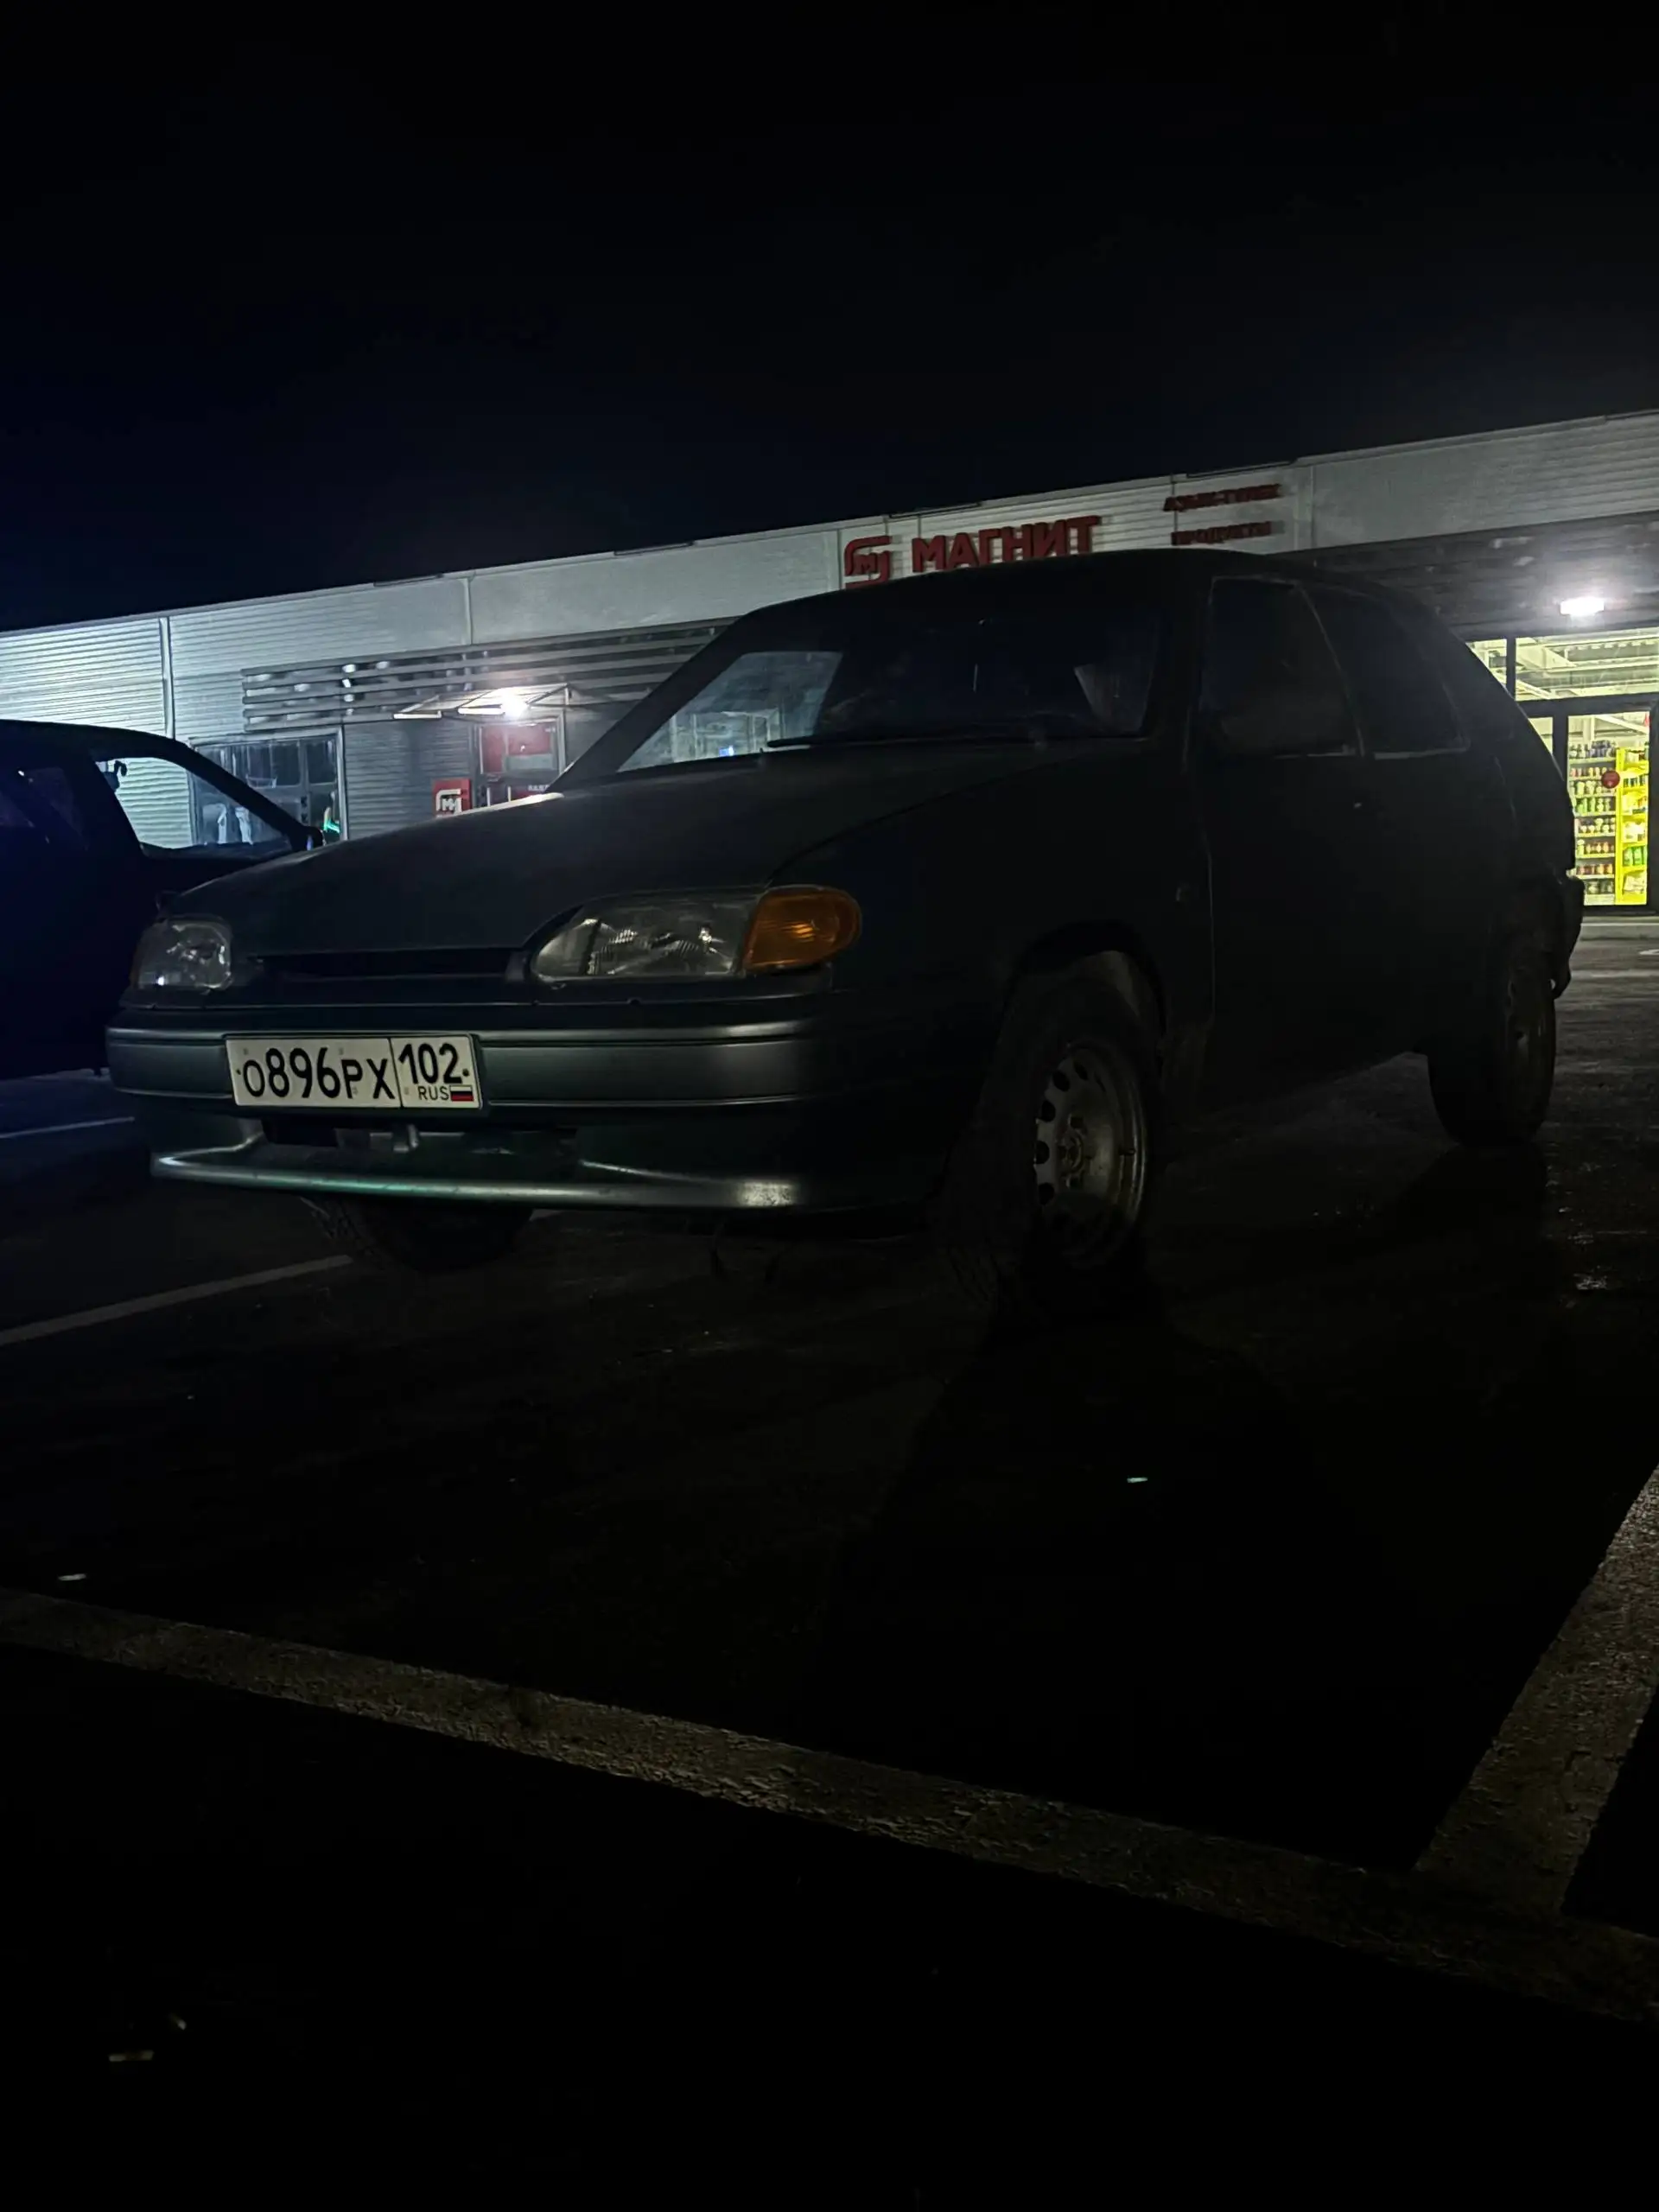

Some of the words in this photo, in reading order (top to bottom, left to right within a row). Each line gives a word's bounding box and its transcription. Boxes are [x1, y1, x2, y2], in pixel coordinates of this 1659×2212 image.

[912, 516, 1102, 573] МАГНИТ
[243, 1047, 395, 1098] О896РХ
[398, 1043, 462, 1084] 102
[418, 1085, 449, 1101] RUS
